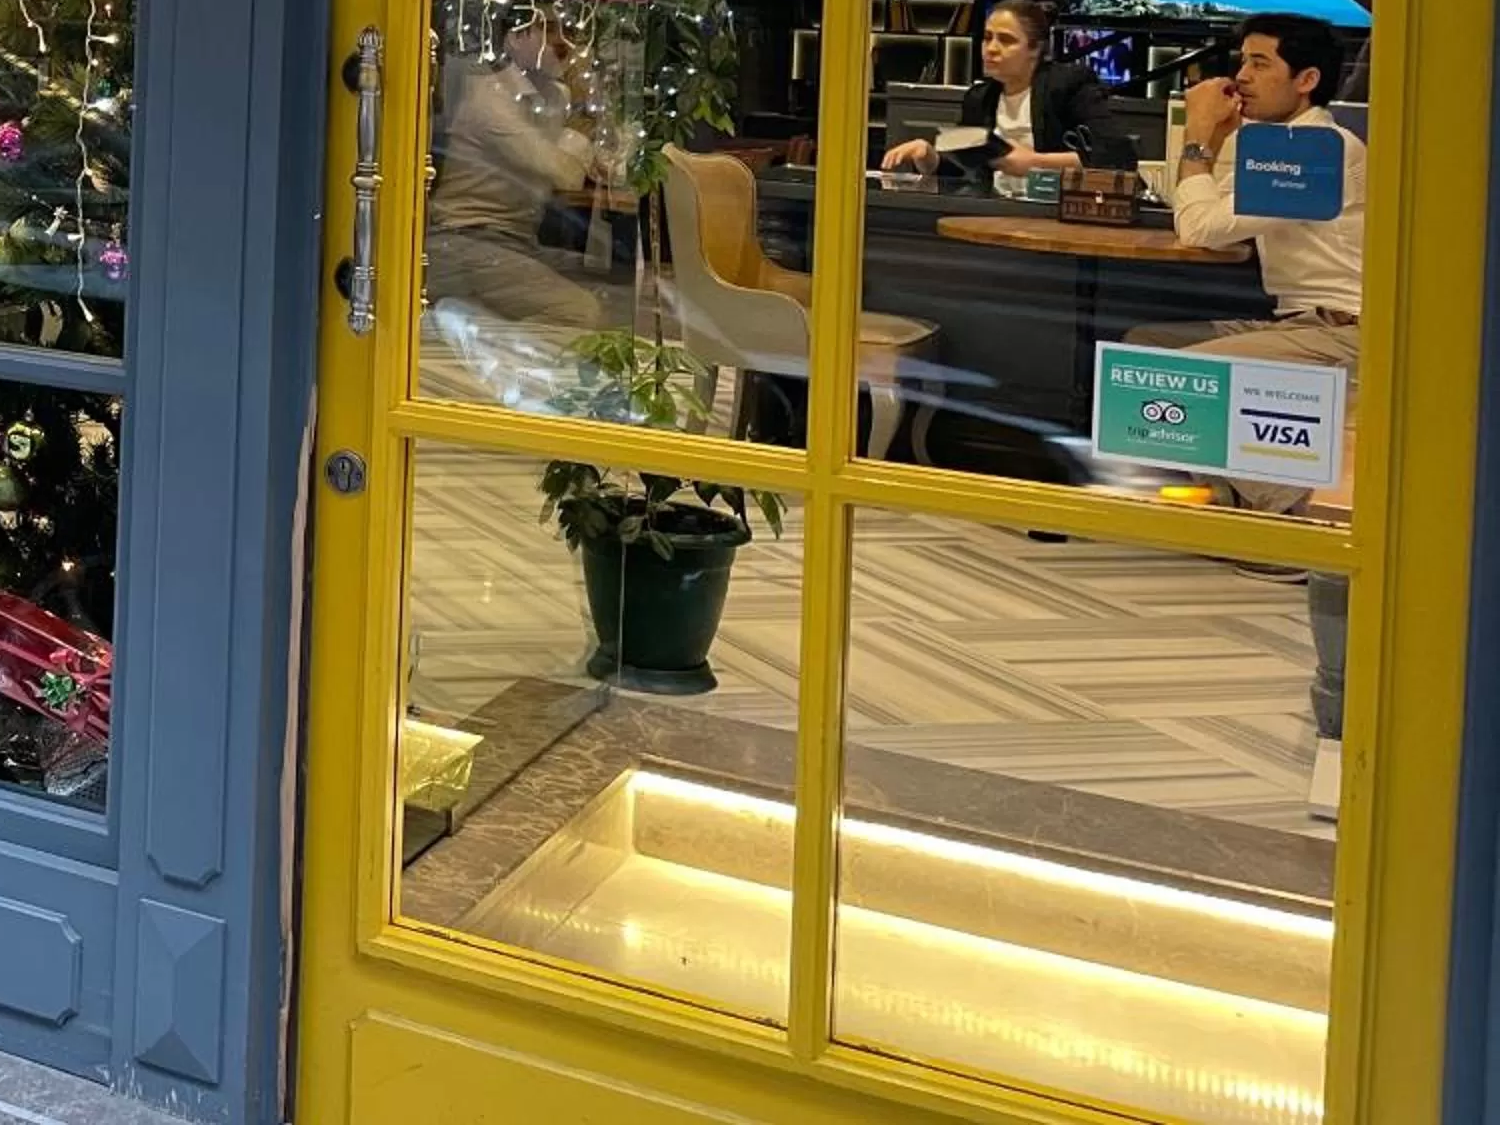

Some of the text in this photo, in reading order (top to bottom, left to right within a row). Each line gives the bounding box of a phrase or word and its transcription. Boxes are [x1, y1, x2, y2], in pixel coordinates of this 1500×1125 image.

[1245, 159, 1301, 176] Booking
[1111, 368, 1219, 393] REVIEW US
[1265, 389, 1320, 403] WELCOME
[1252, 423, 1311, 447] VISA
